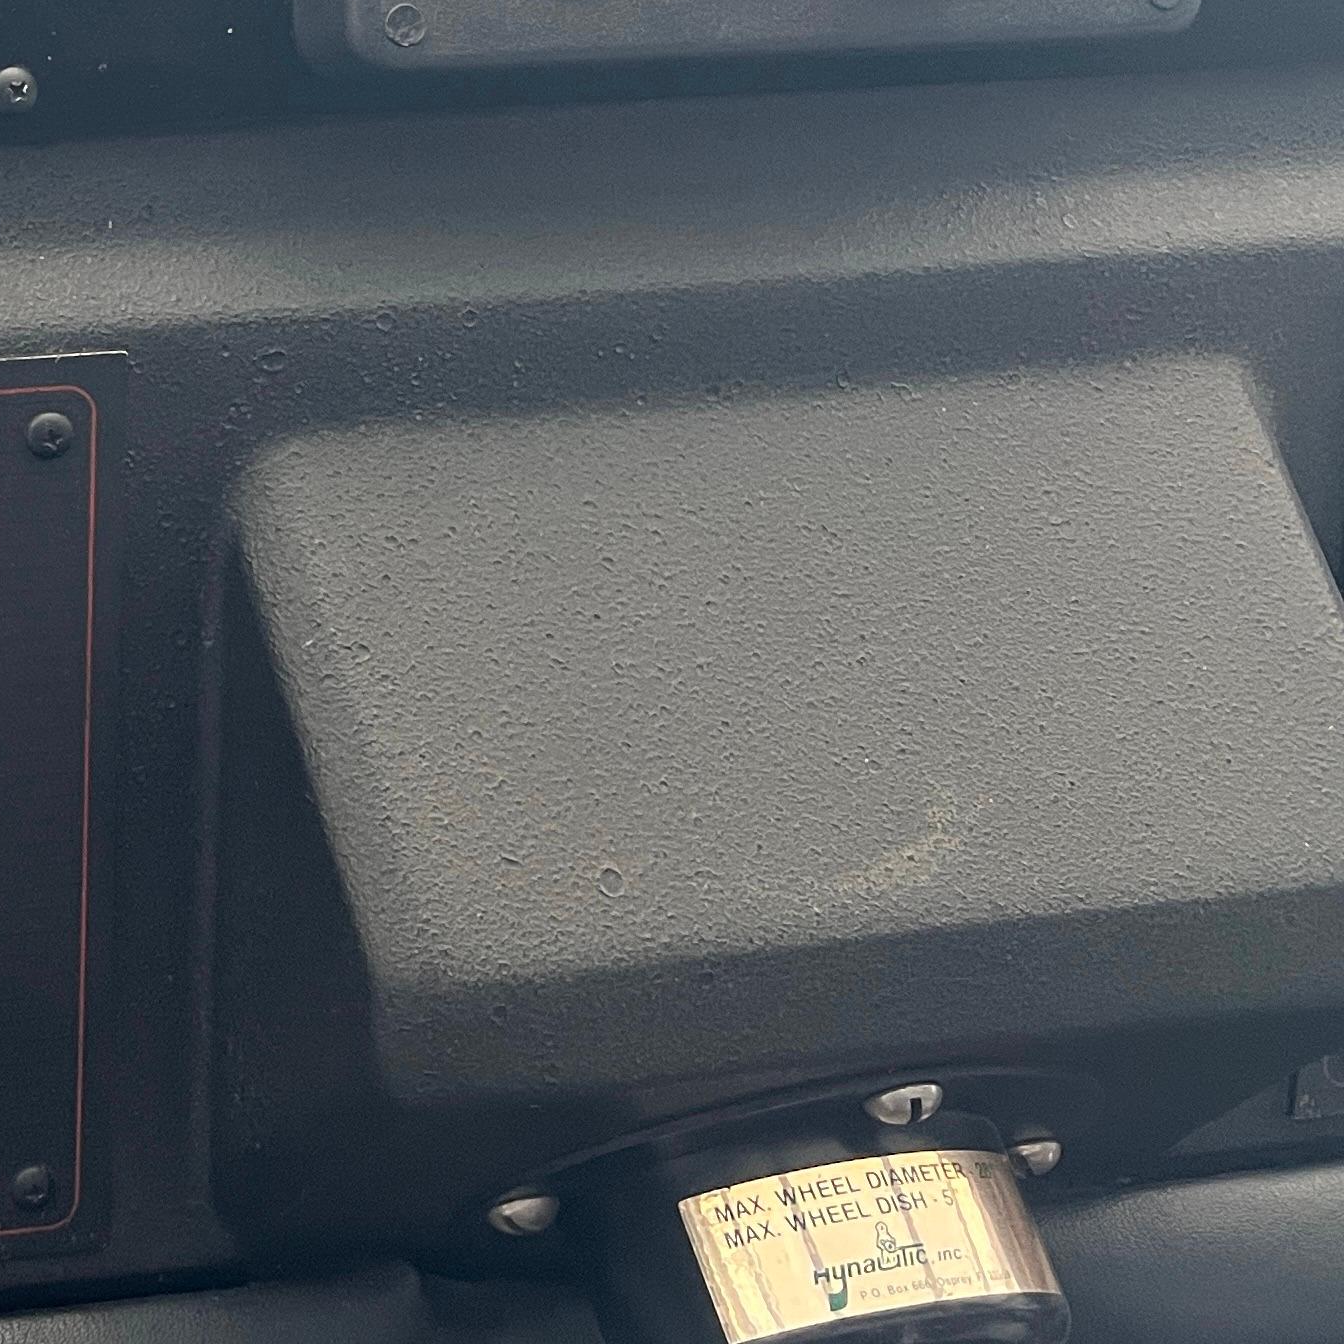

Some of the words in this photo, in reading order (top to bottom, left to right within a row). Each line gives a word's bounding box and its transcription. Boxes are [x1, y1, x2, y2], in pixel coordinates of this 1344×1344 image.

[714, 1194, 771, 1223] MAX.
[775, 1175, 860, 1207] WHEEL
[866, 1162, 968, 1195] DIAMETER
[724, 1222, 782, 1250] MAX.
[786, 1204, 871, 1233] WHEEL
[879, 1190, 928, 1215] DISH
[887, 1283, 909, 1296] Box
